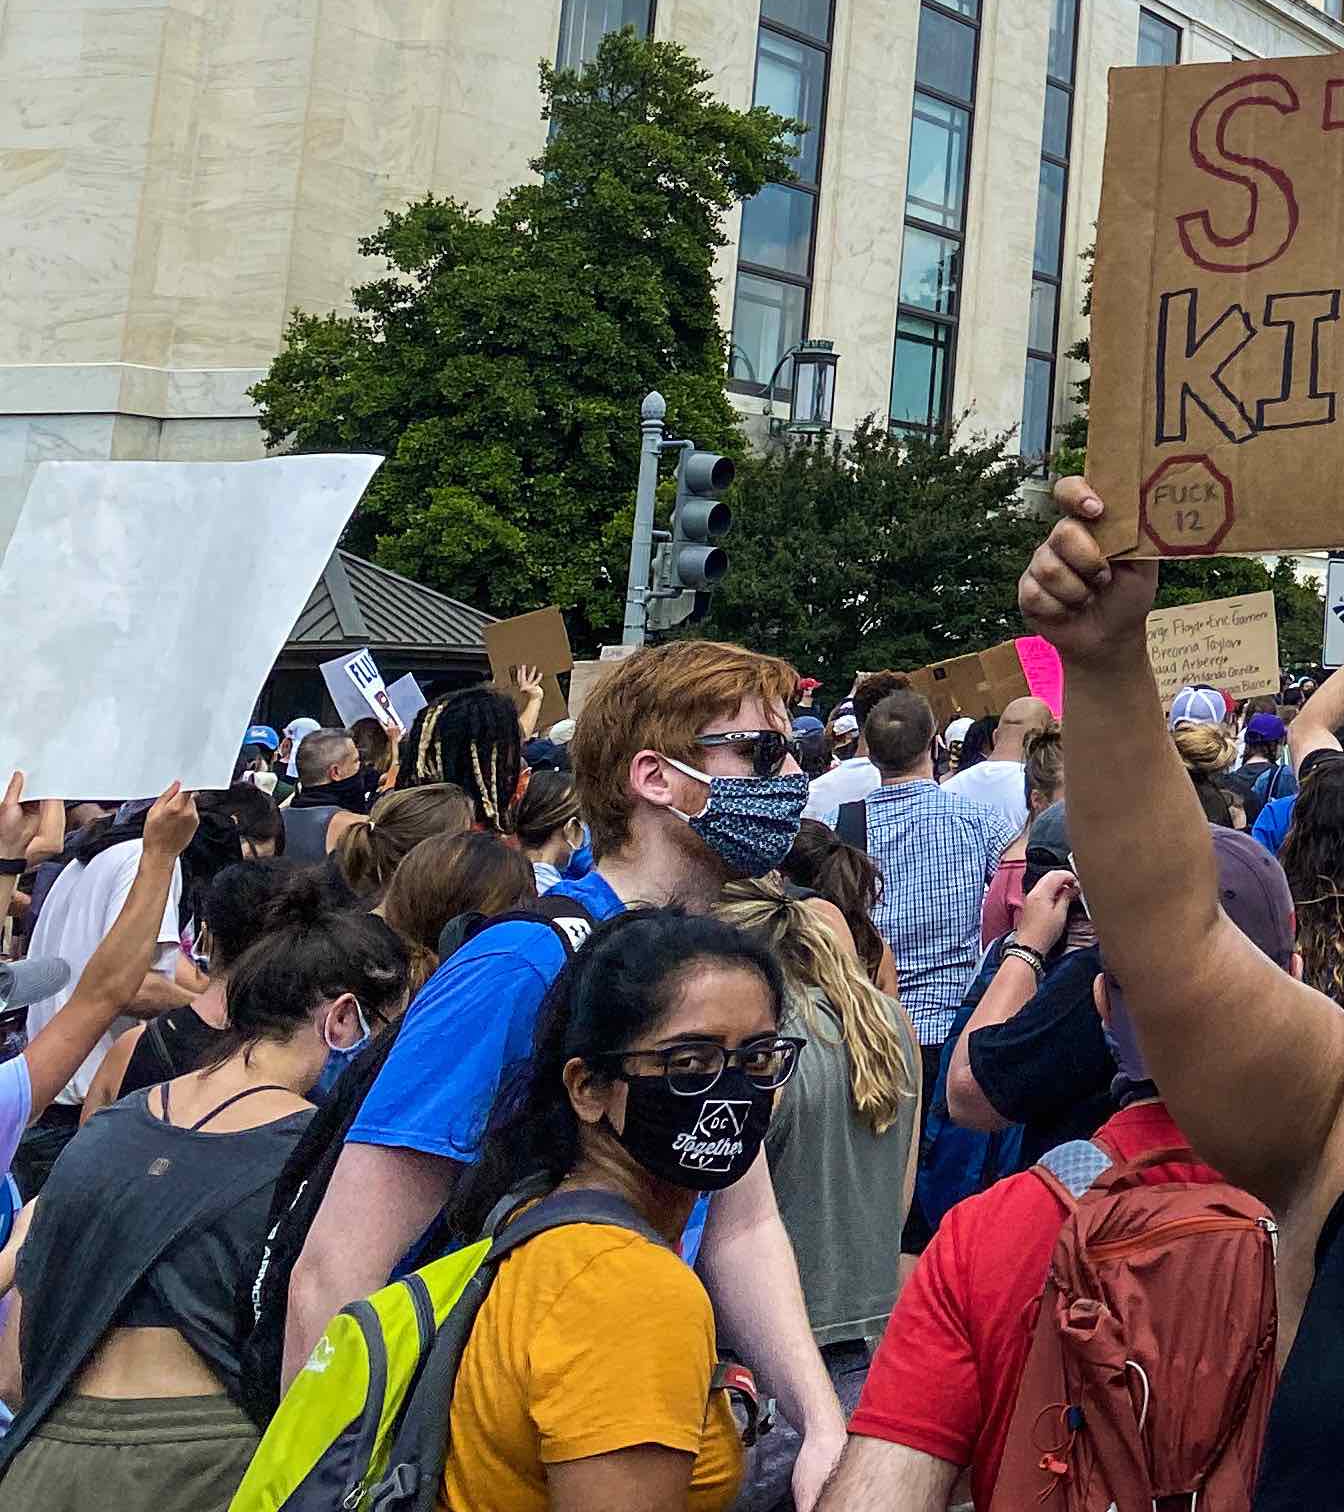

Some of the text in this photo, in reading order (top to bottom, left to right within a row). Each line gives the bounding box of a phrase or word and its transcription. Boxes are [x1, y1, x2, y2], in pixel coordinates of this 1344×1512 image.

[1153, 482, 1216, 505] FUCK
[1175, 509, 1206, 534] 12
[1203, 634, 1238, 653] Taylor
[710, 1117, 729, 1129] DC
[672, 1133, 743, 1160] Together
